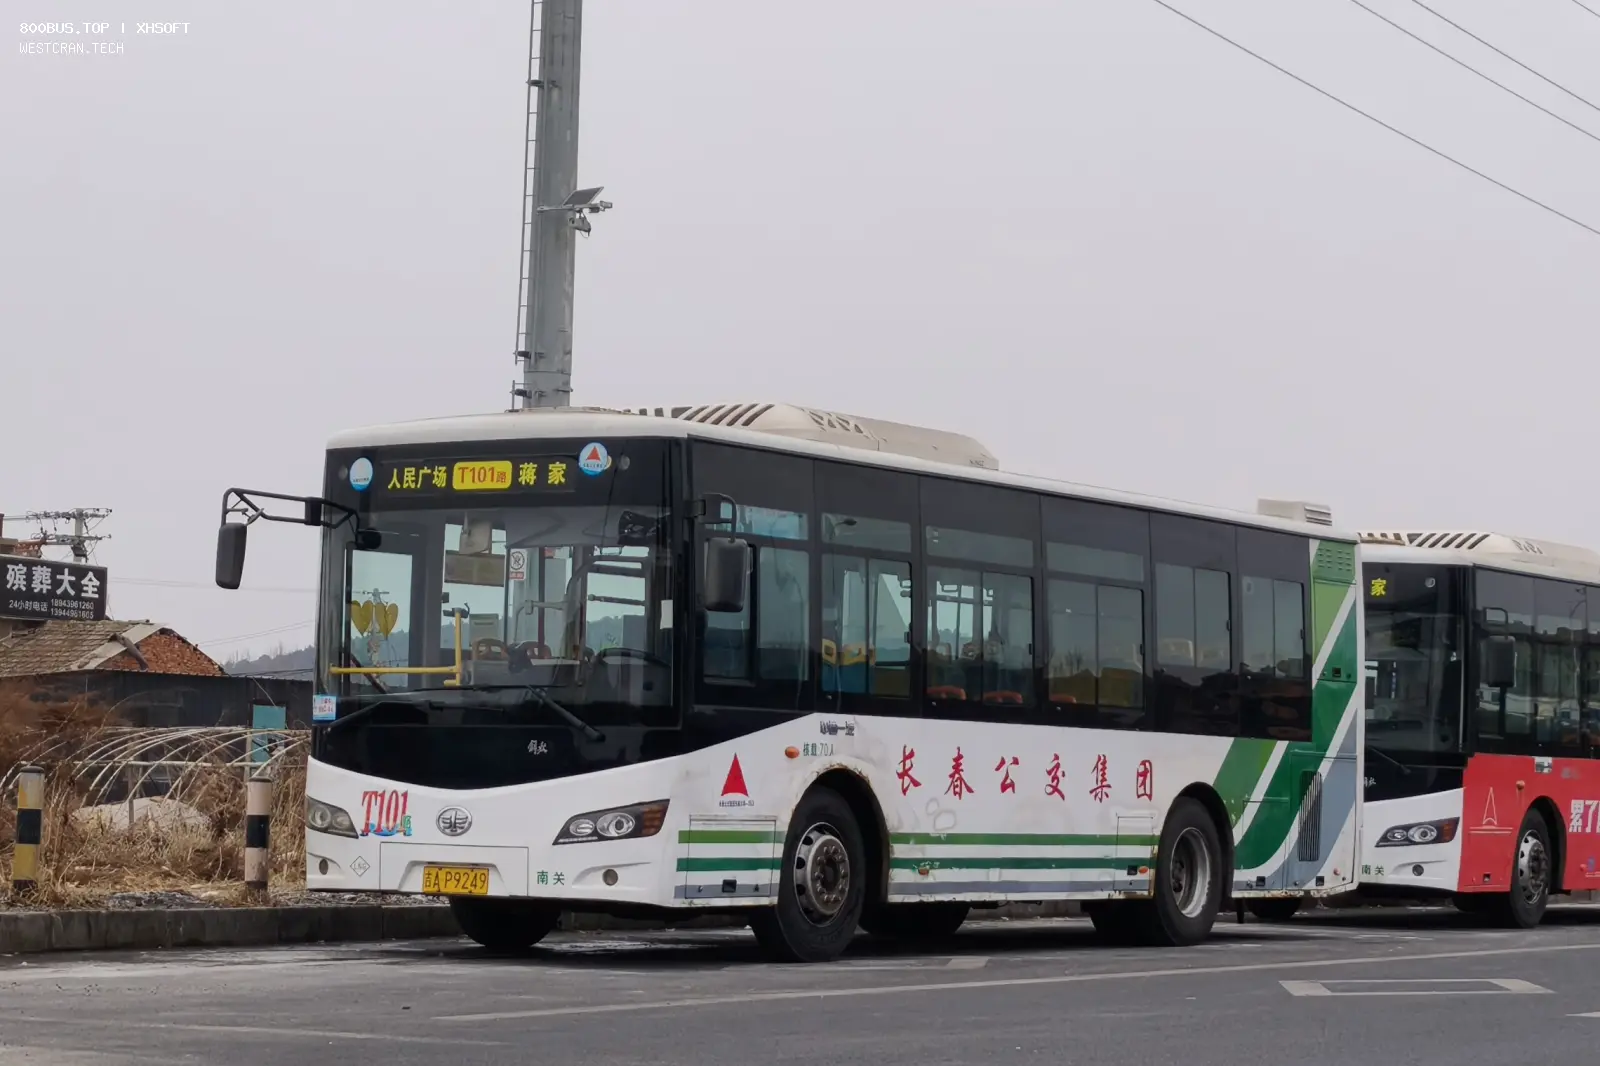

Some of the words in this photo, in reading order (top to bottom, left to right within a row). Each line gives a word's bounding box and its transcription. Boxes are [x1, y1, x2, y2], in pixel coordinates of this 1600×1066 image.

[387, 466, 447, 489] 人民广场
[6, 563, 100, 598] 殡葬大全
[1370, 578, 1387, 596] 家
[8, 599, 48, 612] 24小时电话
[896, 744, 1153, 803] 长春公交集团
[1568, 799, 1600, 833] 累了
[424, 870, 488, 889] 吉AP9249
[536, 870, 565, 886] 南关
[1361, 865, 1385, 876] 南关
